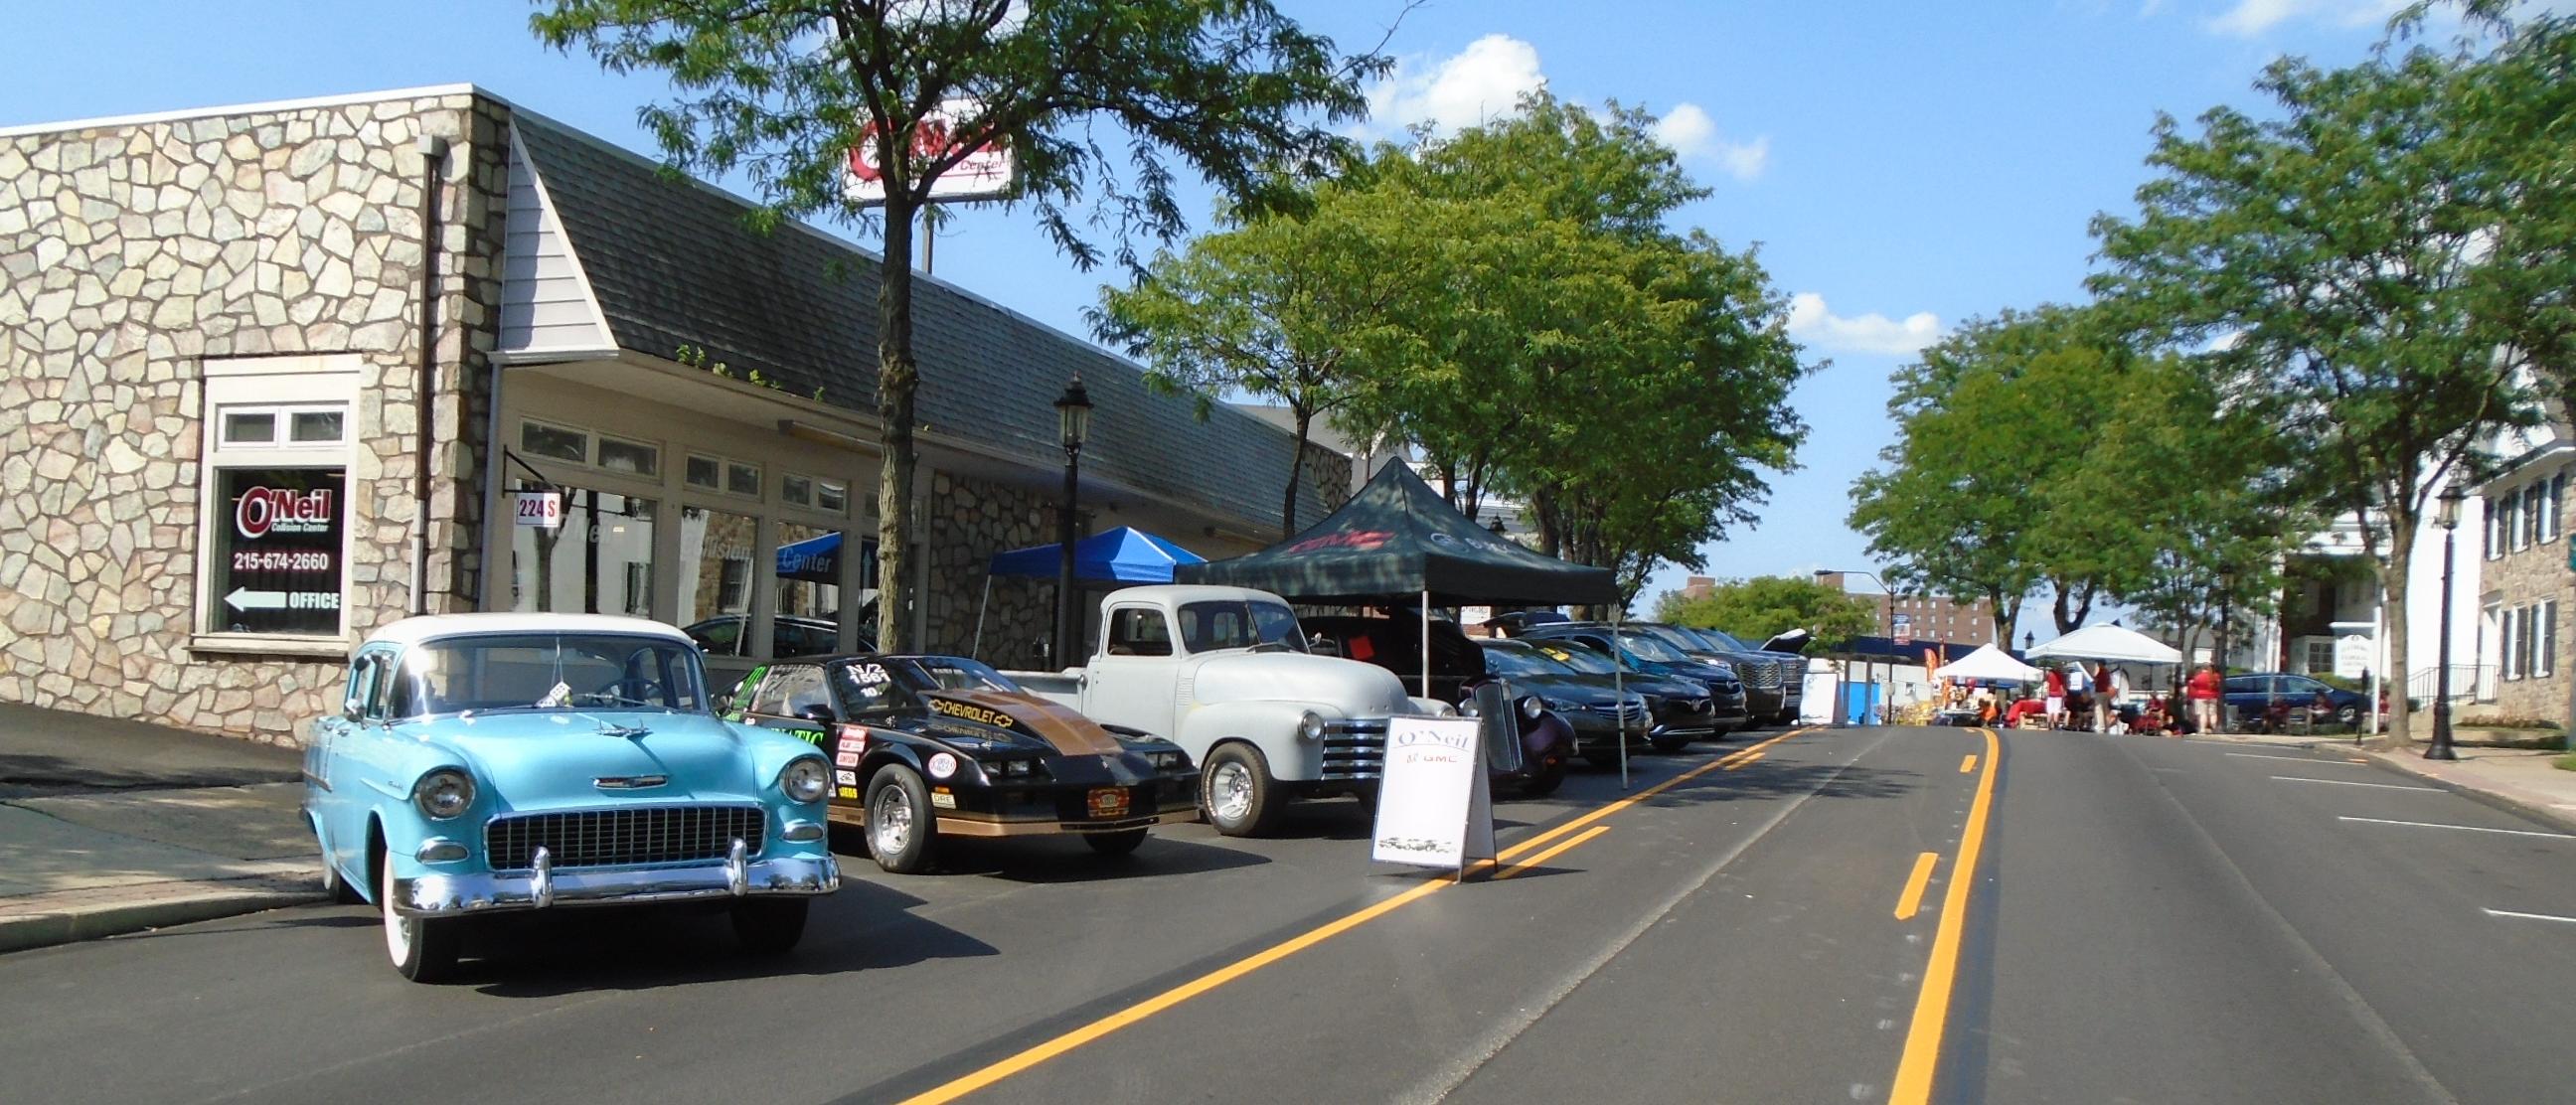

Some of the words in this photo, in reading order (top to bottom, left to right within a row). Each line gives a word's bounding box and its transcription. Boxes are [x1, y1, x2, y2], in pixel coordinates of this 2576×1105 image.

[237, 486, 332, 538] O'Neil
[519, 499, 544, 517] 224
[548, 500, 556, 517] S
[270, 523, 301, 533] Collision
[303, 523, 329, 533] Center
[234, 552, 329, 570] 215-674-2660
[782, 548, 832, 572] Center
[288, 591, 340, 609] OFFICE
[943, 701, 996, 724] CHEVROLET
[1398, 730, 1469, 749] O'Neil
